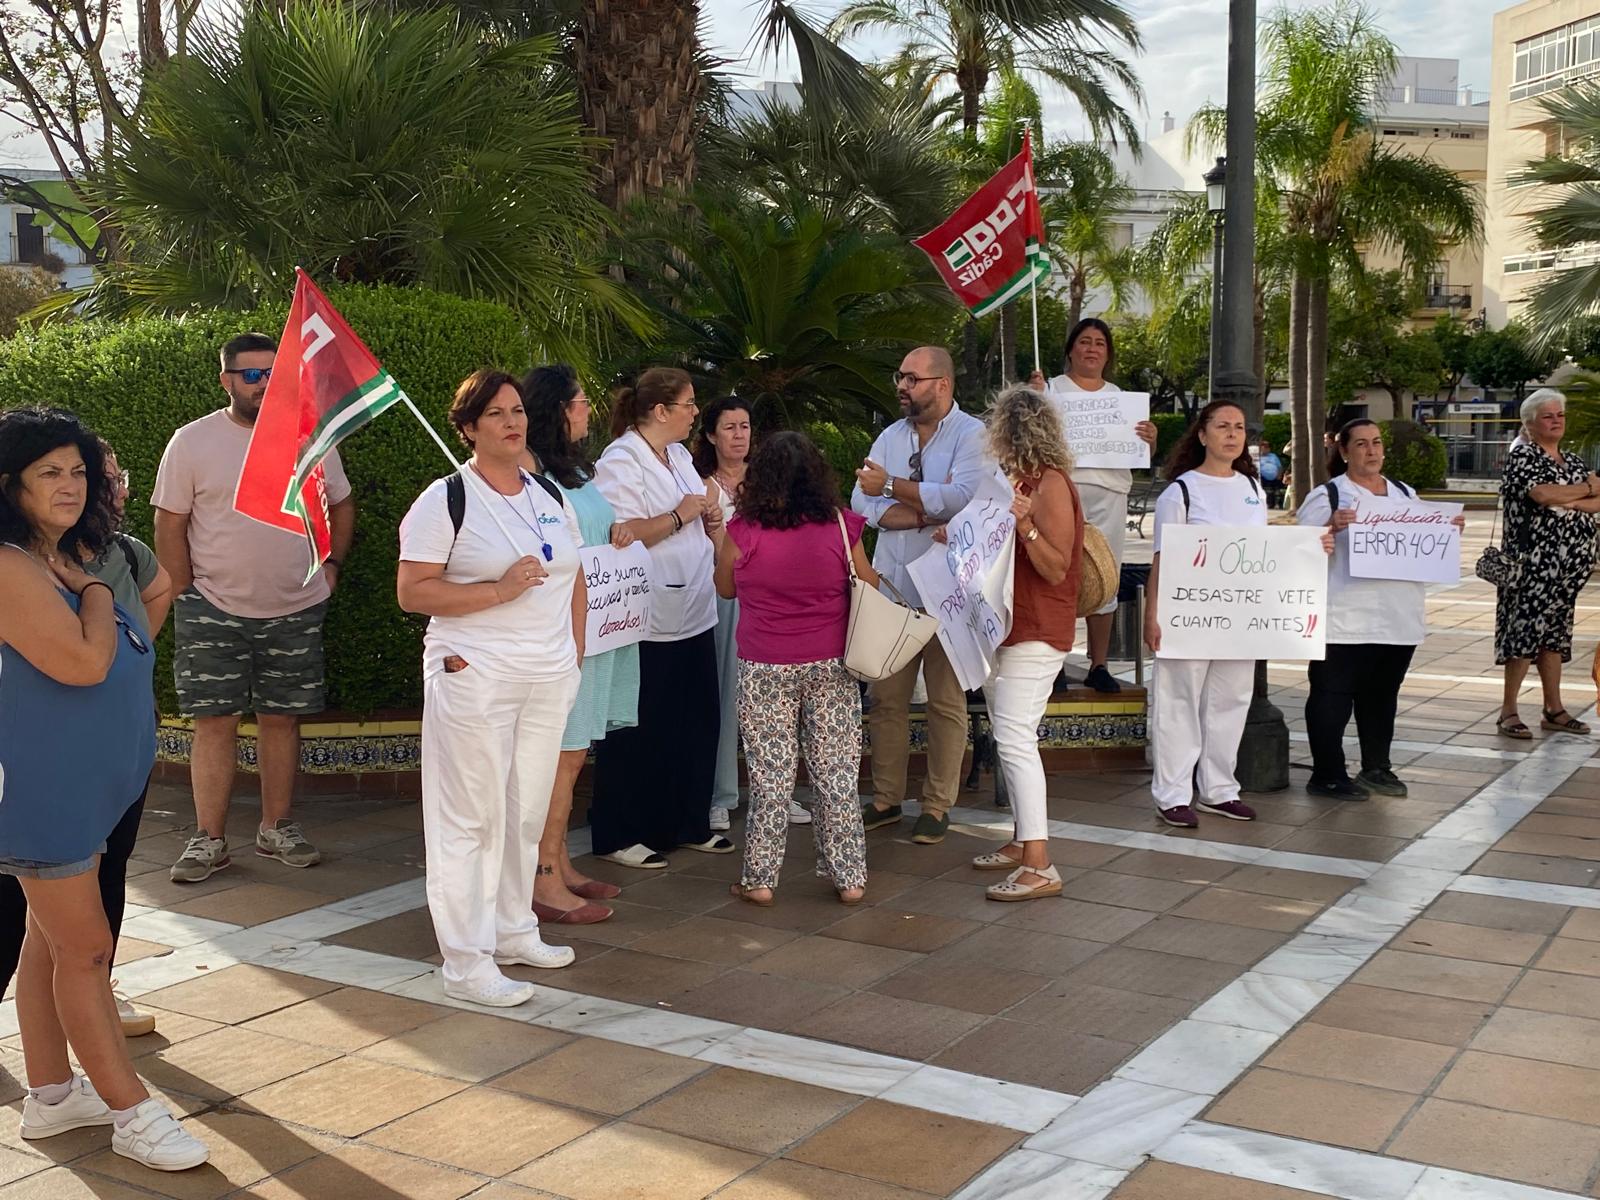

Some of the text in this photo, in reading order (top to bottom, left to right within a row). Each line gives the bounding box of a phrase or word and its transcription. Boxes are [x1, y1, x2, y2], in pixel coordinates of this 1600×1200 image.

[1353, 531, 1407, 556] ERROR
[1220, 538, 1277, 574] Óbolo
[614, 566, 646, 581] suma
[624, 587, 630, 607] y
[1171, 587, 1316, 605] DESASTRE VETE
[1170, 614, 1318, 638] CUANTO ANTES!!
